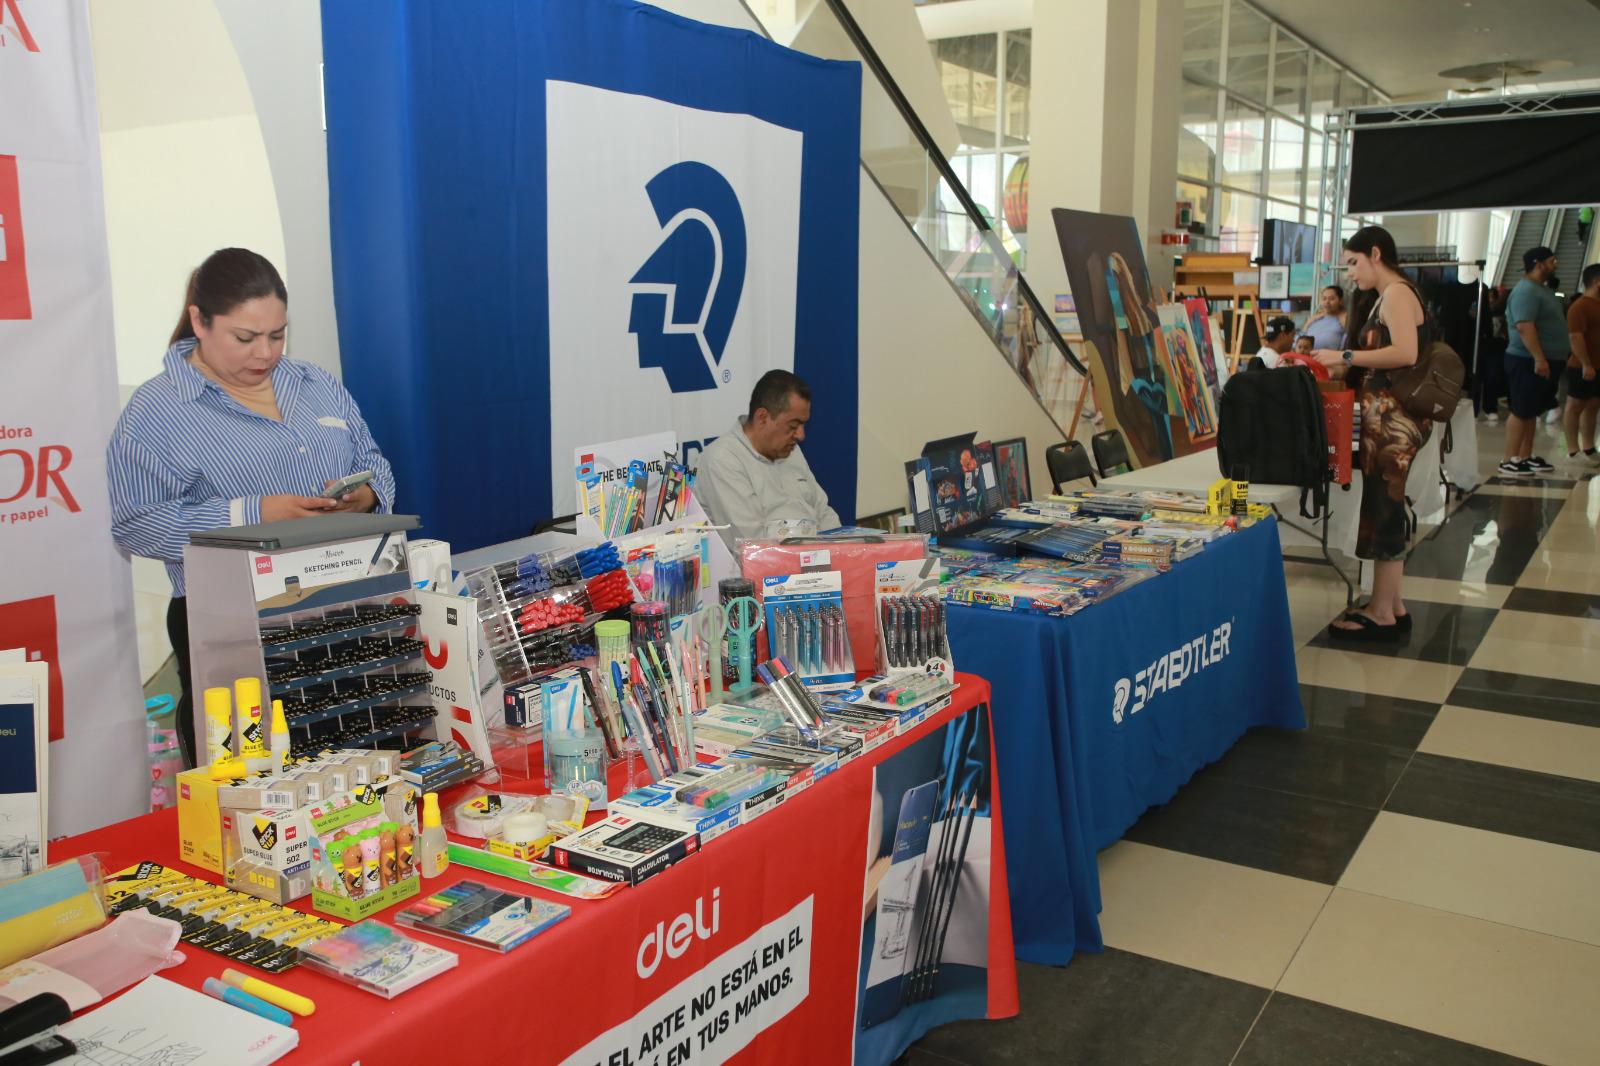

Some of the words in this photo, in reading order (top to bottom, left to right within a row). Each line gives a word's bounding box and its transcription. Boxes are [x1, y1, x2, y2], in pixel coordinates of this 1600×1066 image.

[10, 507, 49, 524] papel
[303, 560, 340, 574] SKETCHING
[341, 558, 364, 568] PENCIL
[1130, 622, 1232, 715] STAEDTLER
[0, 728, 17, 736] eli
[749, 793, 765, 806] THINK
[699, 817, 717, 831] THINK
[243, 846, 259, 858] SUPER
[285, 840, 308, 854] SUPER
[286, 853, 301, 865] 502
[637, 853, 670, 876] CALCULATOR
[587, 865, 625, 882] CALCULATOR
[636, 886, 720, 979] deli
[638, 1005, 686, 1061] ARTE
[691, 985, 716, 1021] NO
[720, 950, 758, 1000] ESTÁ
[762, 938, 784, 969] EN
[788, 925, 804, 955] EL
[667, 1036, 690, 1066] EN
[697, 1009, 729, 1052] TUS
[735, 966, 794, 1025] MANOS.
